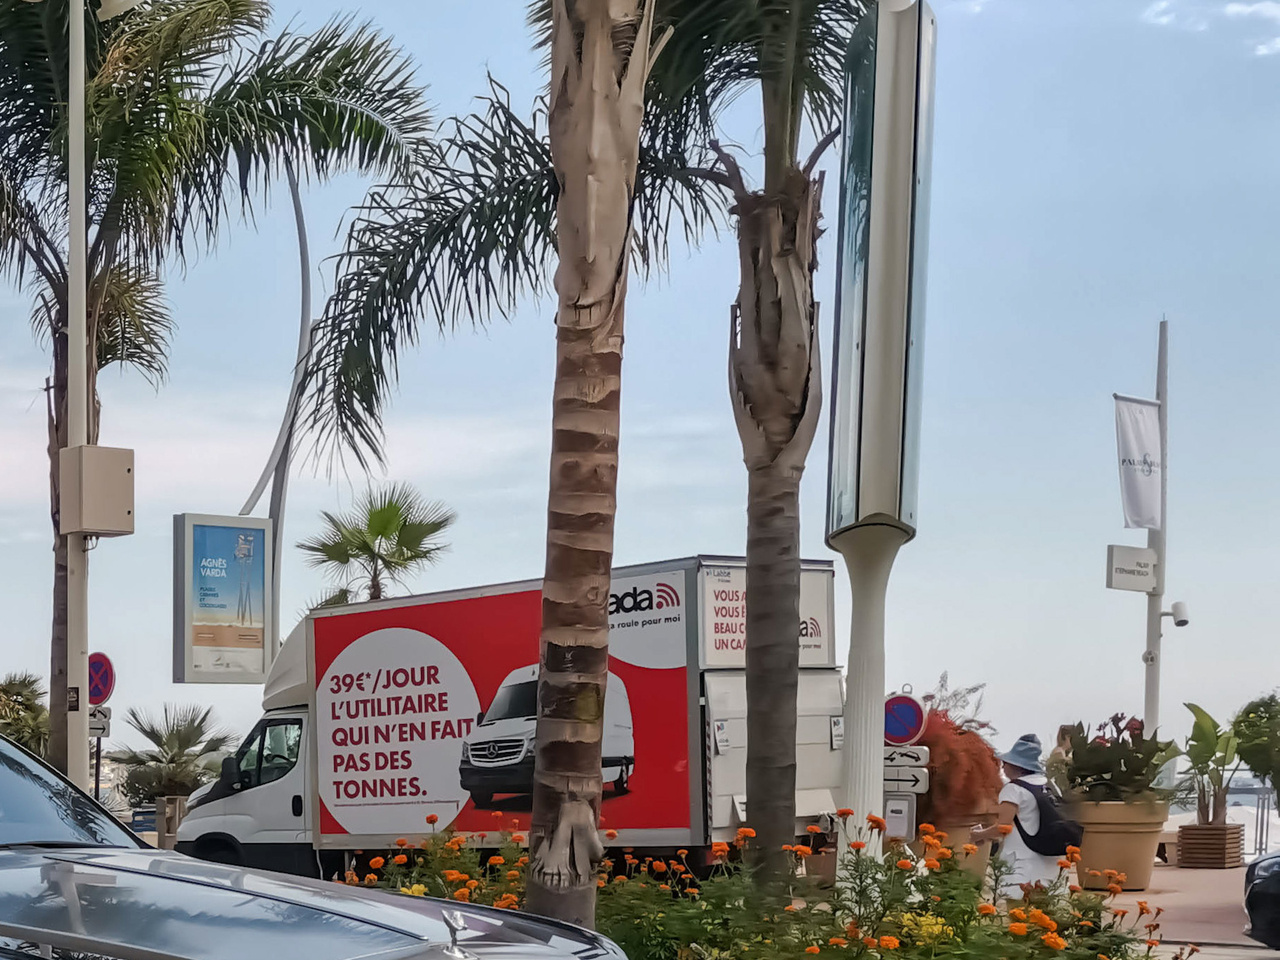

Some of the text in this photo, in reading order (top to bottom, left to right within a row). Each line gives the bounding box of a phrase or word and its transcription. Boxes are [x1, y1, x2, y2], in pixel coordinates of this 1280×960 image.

[200, 557, 227, 568] AGNÈS
[200, 568, 227, 578] VARDA
[714, 590, 739, 601] VOUS
[714, 606, 739, 618] VOUS
[618, 619, 639, 629] roule
[642, 618, 662, 628] pour
[664, 614, 681, 623] moi
[714, 622, 737, 634] BEAU
[714, 639, 728, 650] UN
[331, 692, 448, 720] L'UTILITAIRE
[332, 718, 474, 747] QUI N'EN FAIT
[333, 750, 412, 773] PAS DES
[333, 777, 427, 799] TONNES.
